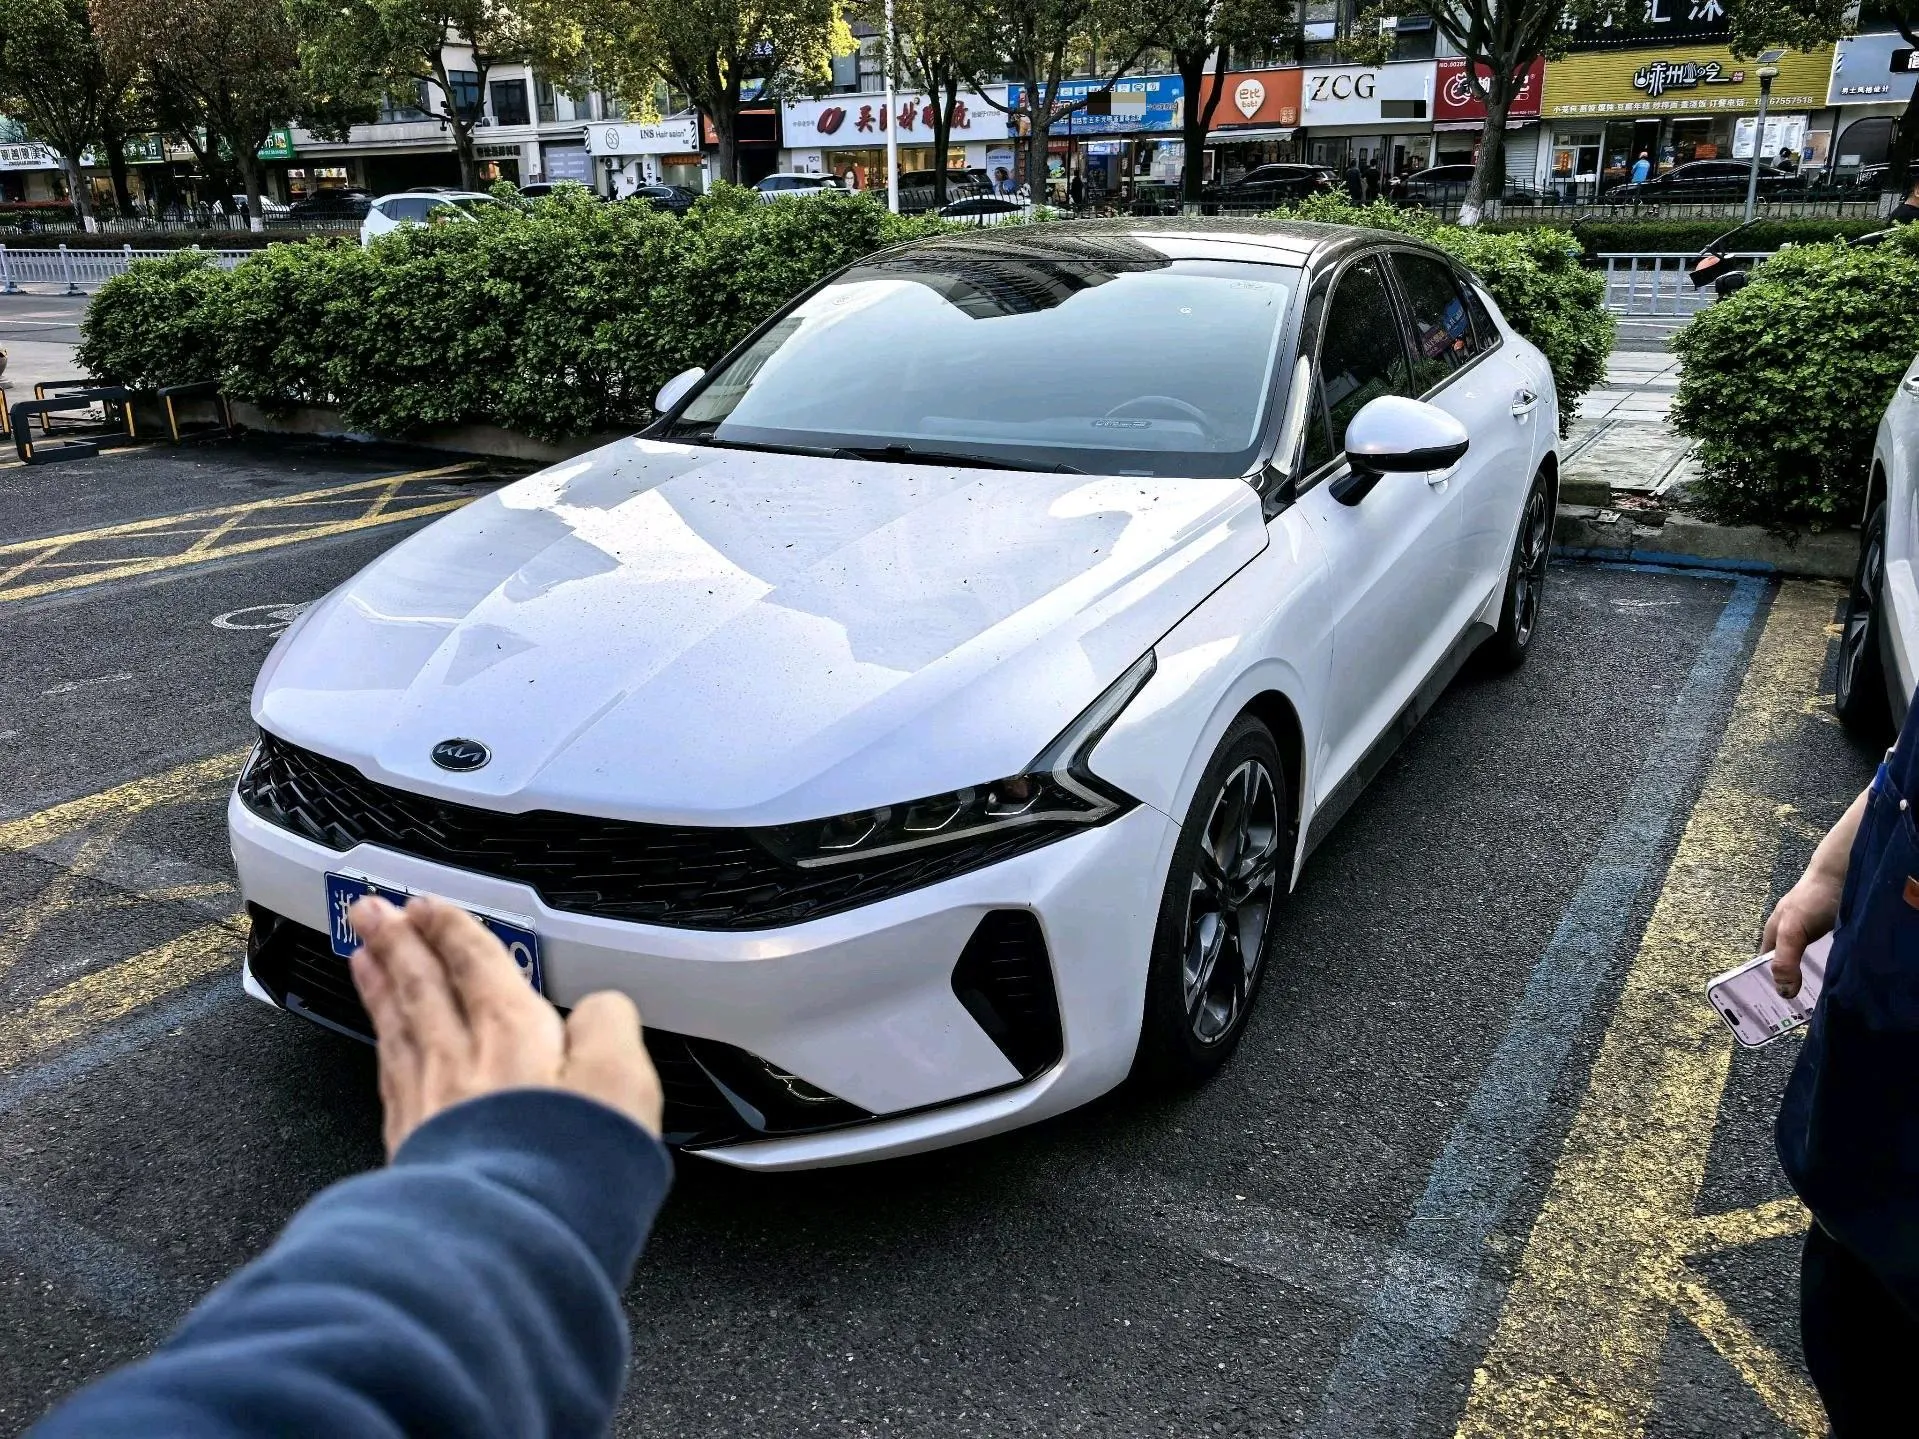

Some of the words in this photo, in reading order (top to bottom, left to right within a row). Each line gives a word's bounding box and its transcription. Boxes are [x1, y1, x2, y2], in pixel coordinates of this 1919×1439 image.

[1311, 74, 1375, 101] ZCG
[1239, 88, 1261, 100] 巴比
[1754, 96, 1813, 106] 167557518
[640, 129, 654, 139] INS
